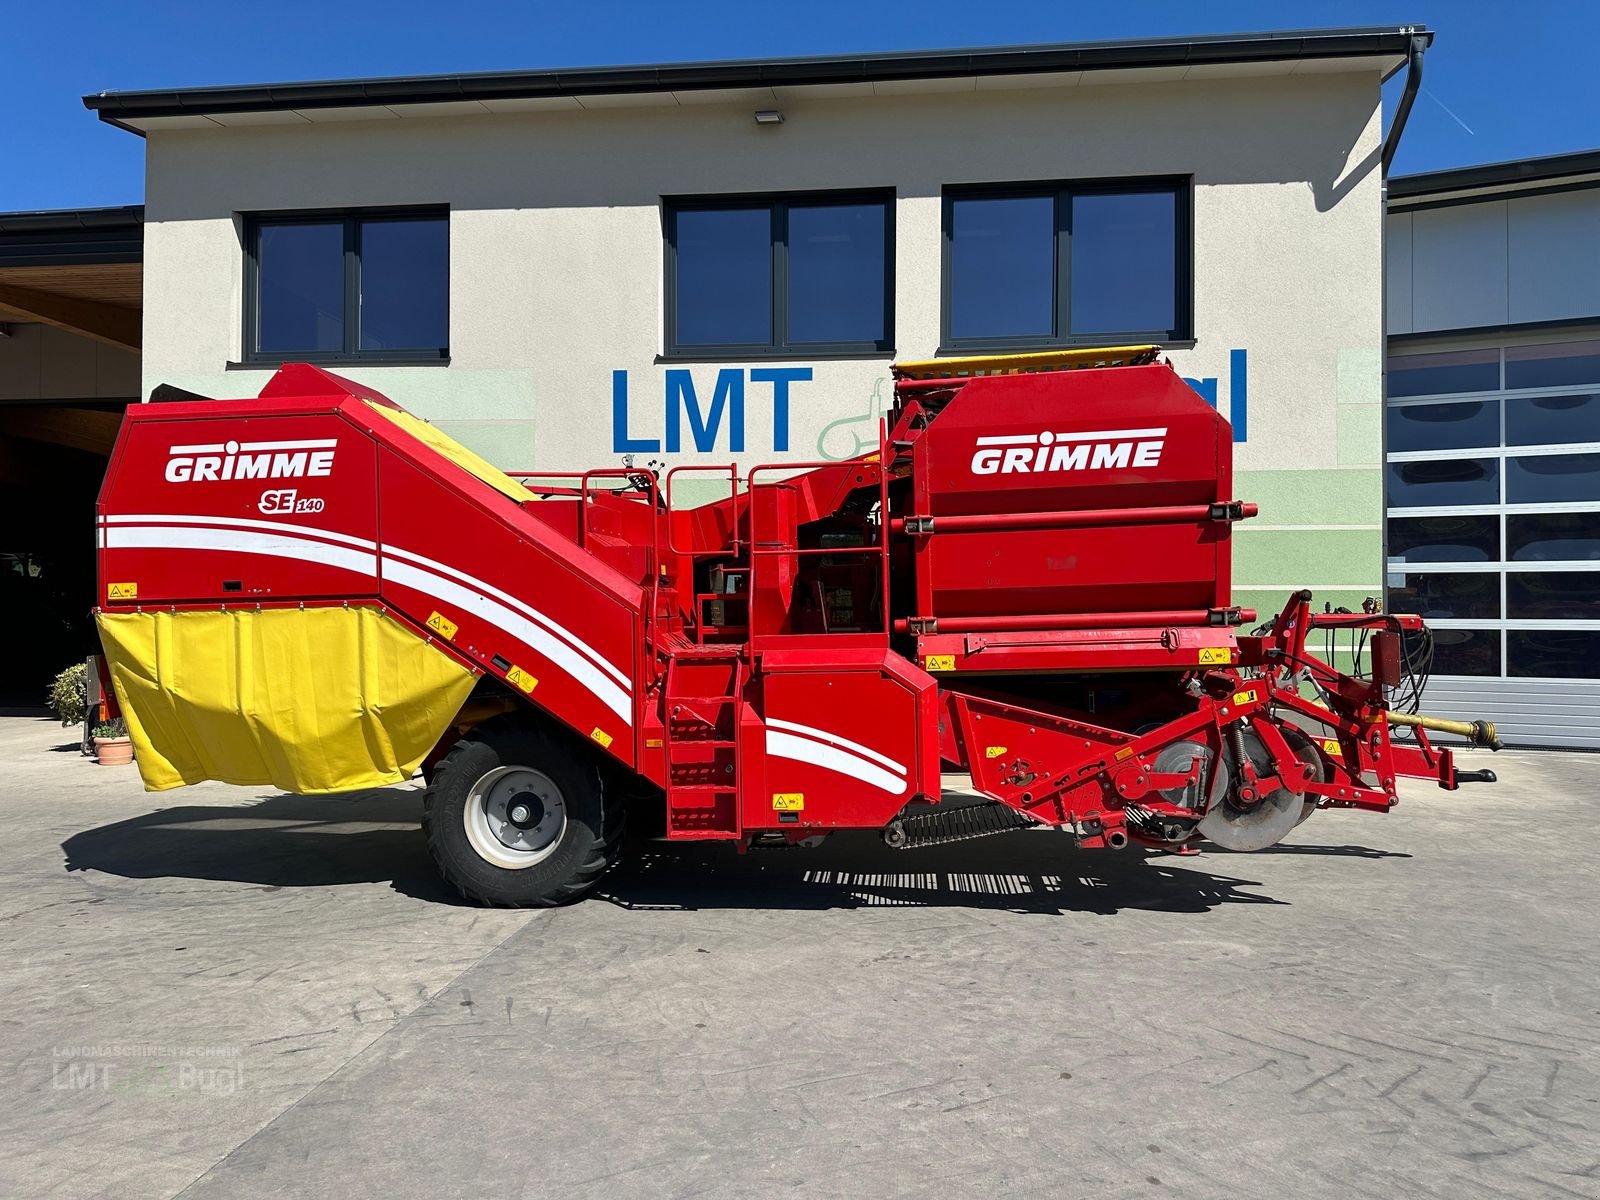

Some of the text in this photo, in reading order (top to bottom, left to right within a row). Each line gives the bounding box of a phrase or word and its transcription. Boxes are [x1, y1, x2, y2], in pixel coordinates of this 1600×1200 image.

[613, 367, 813, 453] LMT
[164, 440, 336, 483] GRIMME
[970, 431, 1165, 475] GRIMME
[258, 489, 324, 514] SE 140
